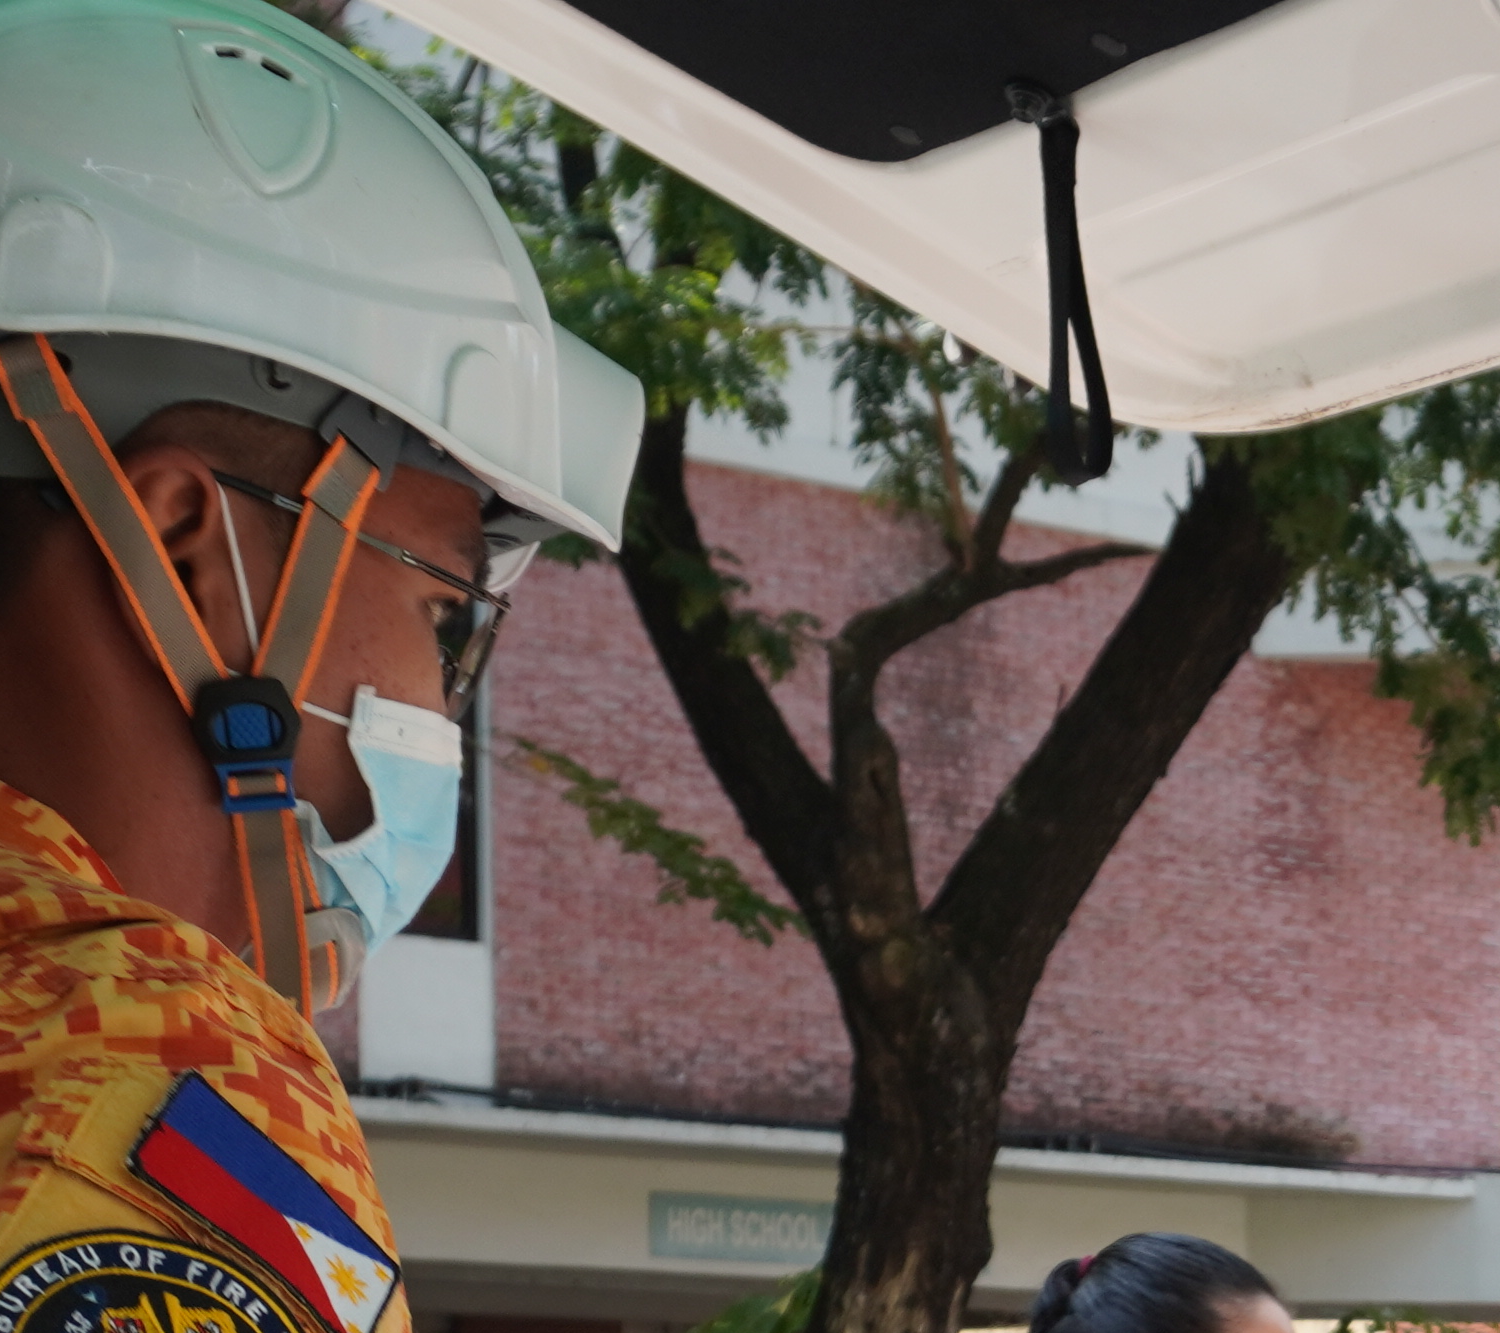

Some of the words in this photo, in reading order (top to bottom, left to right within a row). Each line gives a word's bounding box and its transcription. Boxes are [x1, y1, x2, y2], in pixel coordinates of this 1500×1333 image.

[668, 1206, 725, 1245] HIGH
[731, 1210, 826, 1250] SCHOOL
[119, 1243, 167, 1275] OF
[185, 1259, 269, 1324] FIRE
